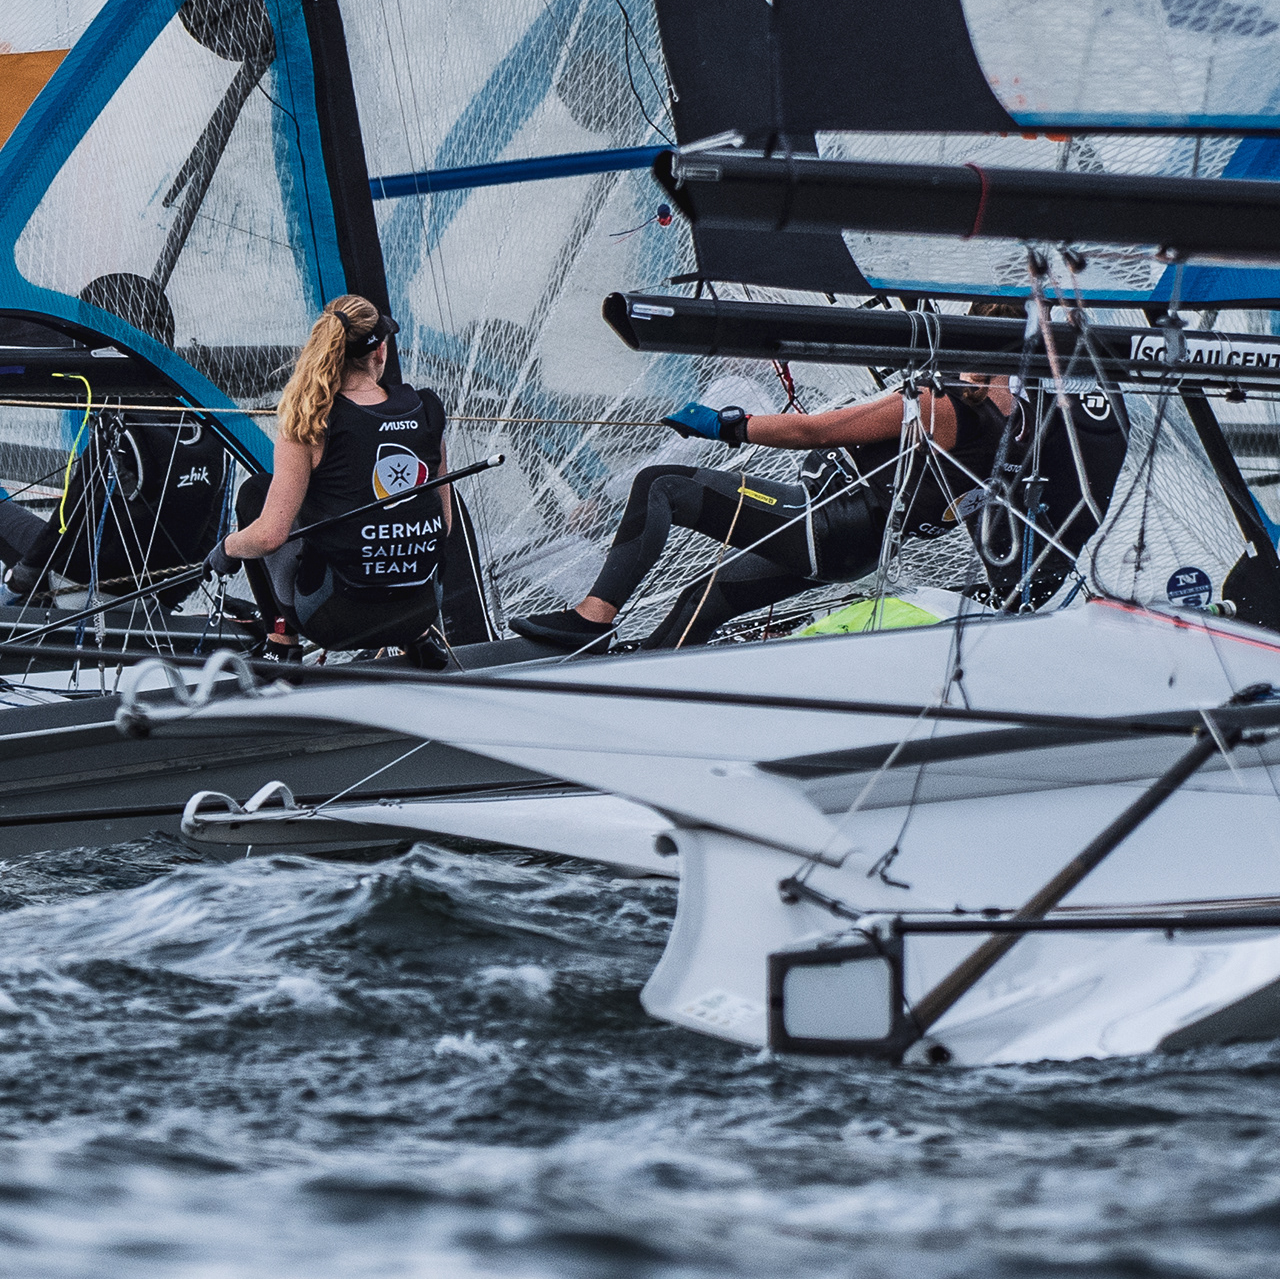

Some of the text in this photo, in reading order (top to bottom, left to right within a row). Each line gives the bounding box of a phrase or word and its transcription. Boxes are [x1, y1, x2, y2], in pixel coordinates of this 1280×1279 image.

[378, 420, 419, 432] MUSTO
[177, 466, 211, 488] zhik
[361, 516, 442, 540] GERMAN
[361, 539, 438, 558] SAILING
[362, 560, 418, 575] TEAM
